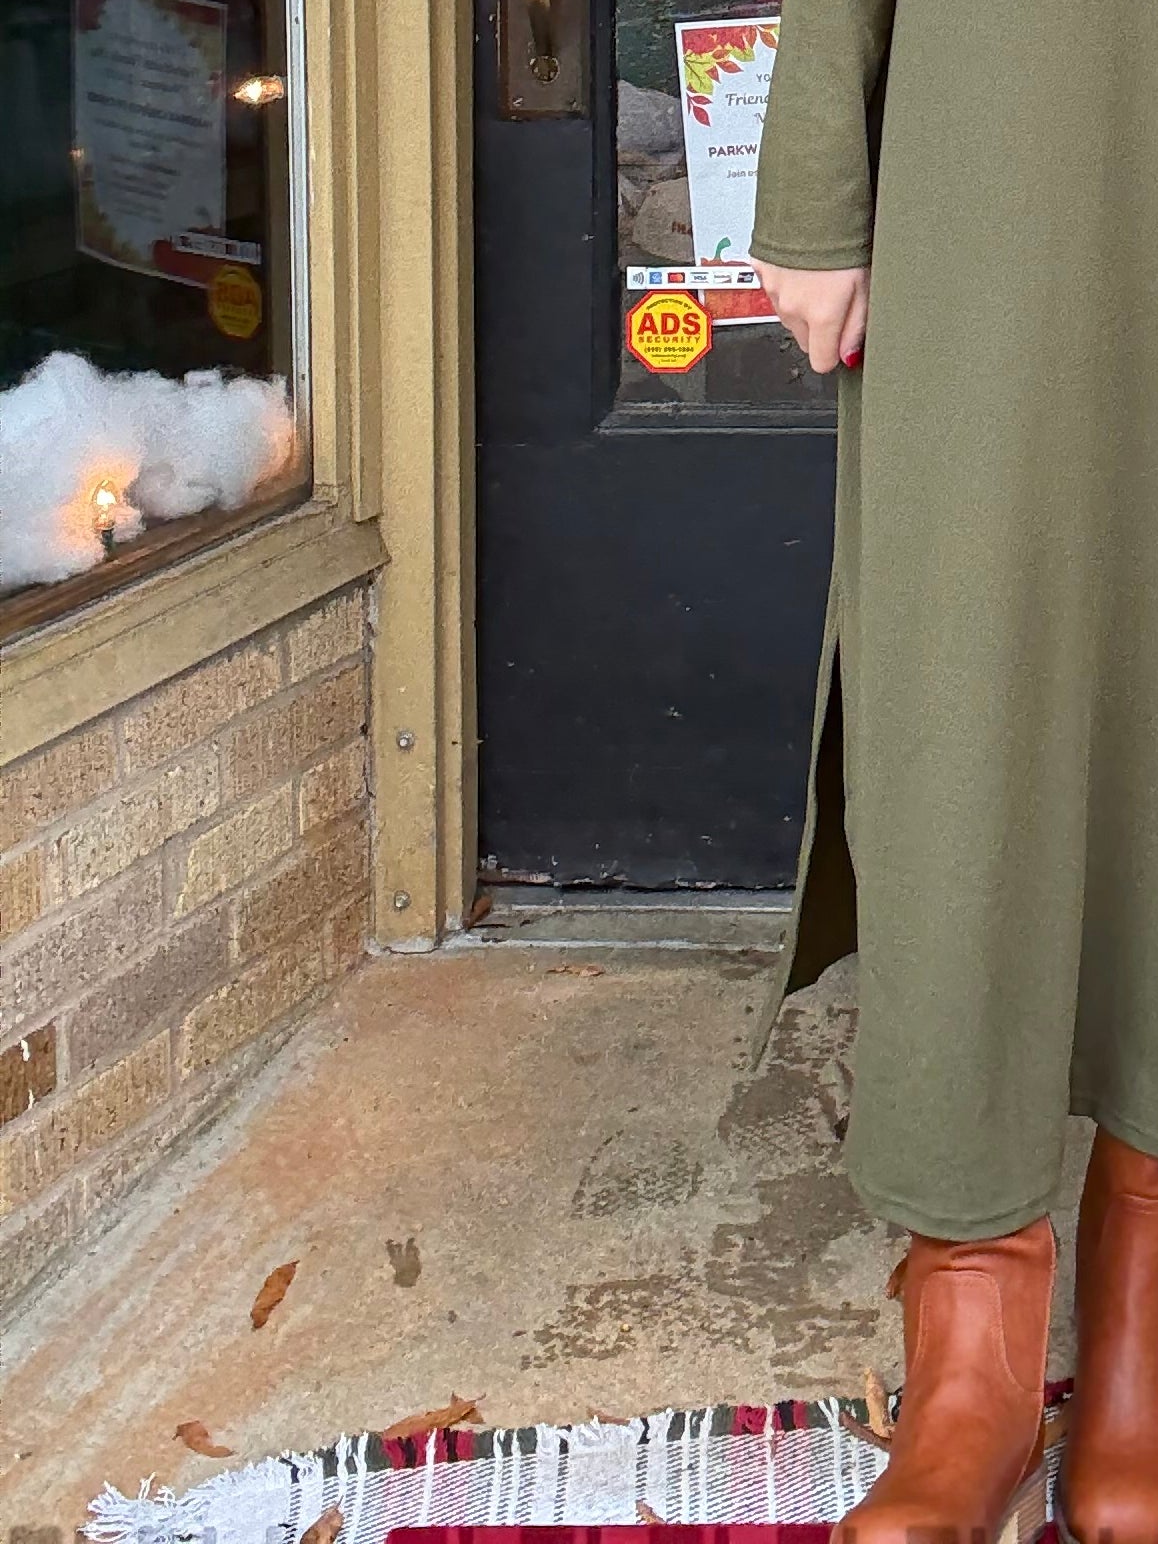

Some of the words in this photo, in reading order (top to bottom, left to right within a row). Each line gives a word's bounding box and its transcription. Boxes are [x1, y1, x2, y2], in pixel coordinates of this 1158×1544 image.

[756, 72, 771, 82] YO
[708, 143, 757, 158] PARKW
[637, 312, 701, 336] ADS
[638, 335, 701, 344] SECURITY
